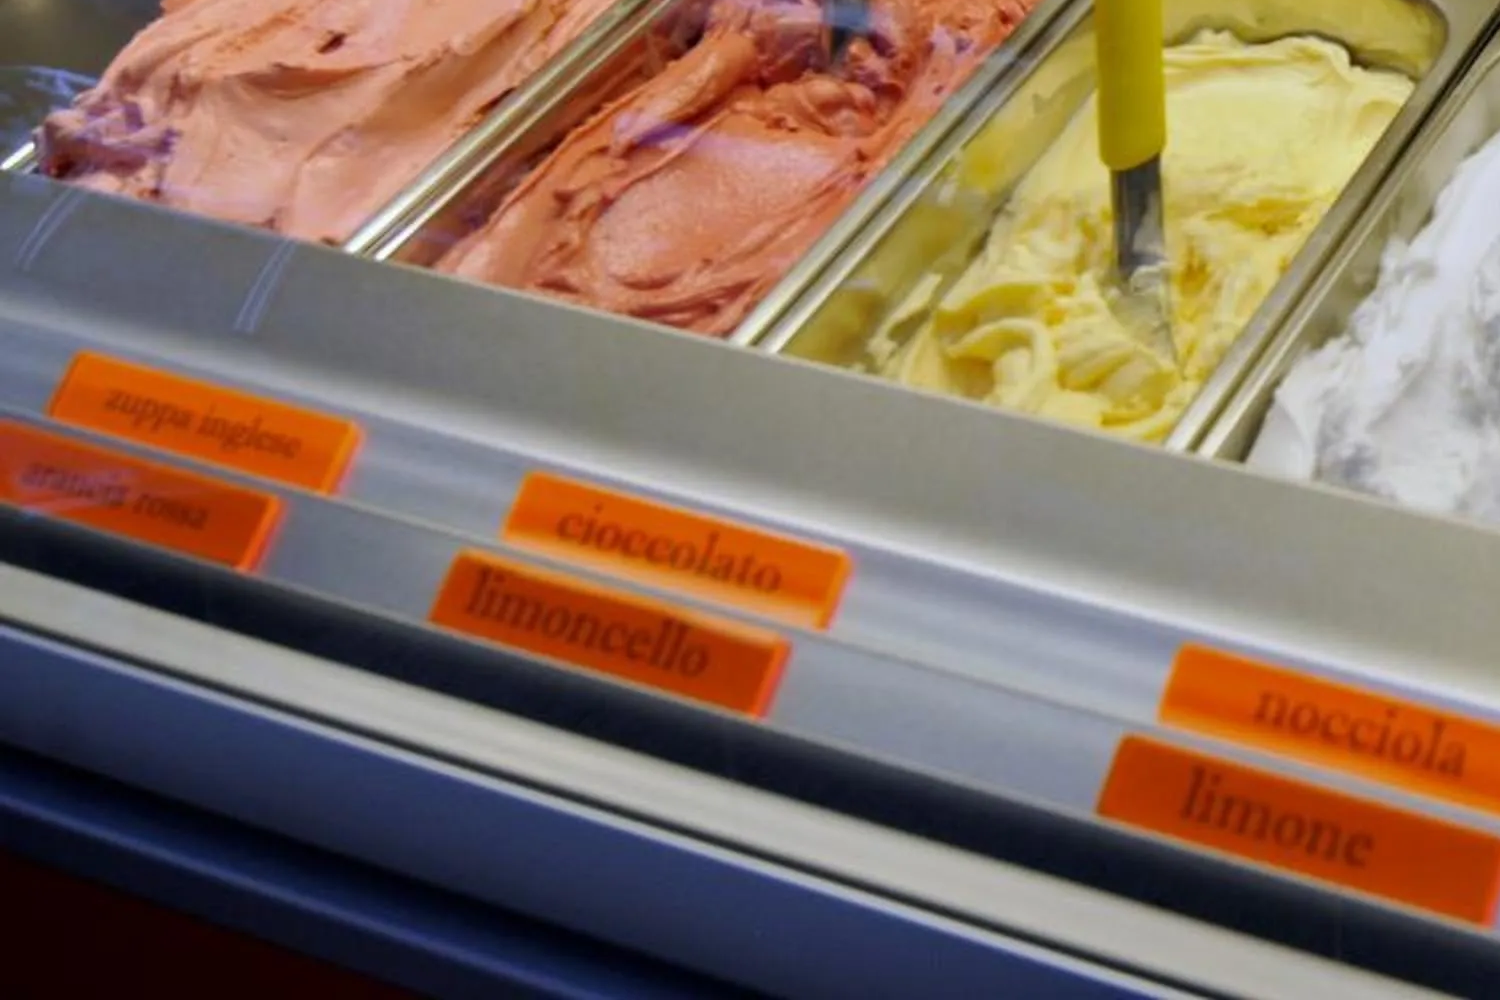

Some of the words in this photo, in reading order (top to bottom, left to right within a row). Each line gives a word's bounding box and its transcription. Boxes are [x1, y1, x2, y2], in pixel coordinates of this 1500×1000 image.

[555, 503, 782, 594] cioccolato
[465, 563, 710, 679] limoncello
[1251, 687, 1470, 779] nocciola
[1177, 763, 1376, 870] limone
